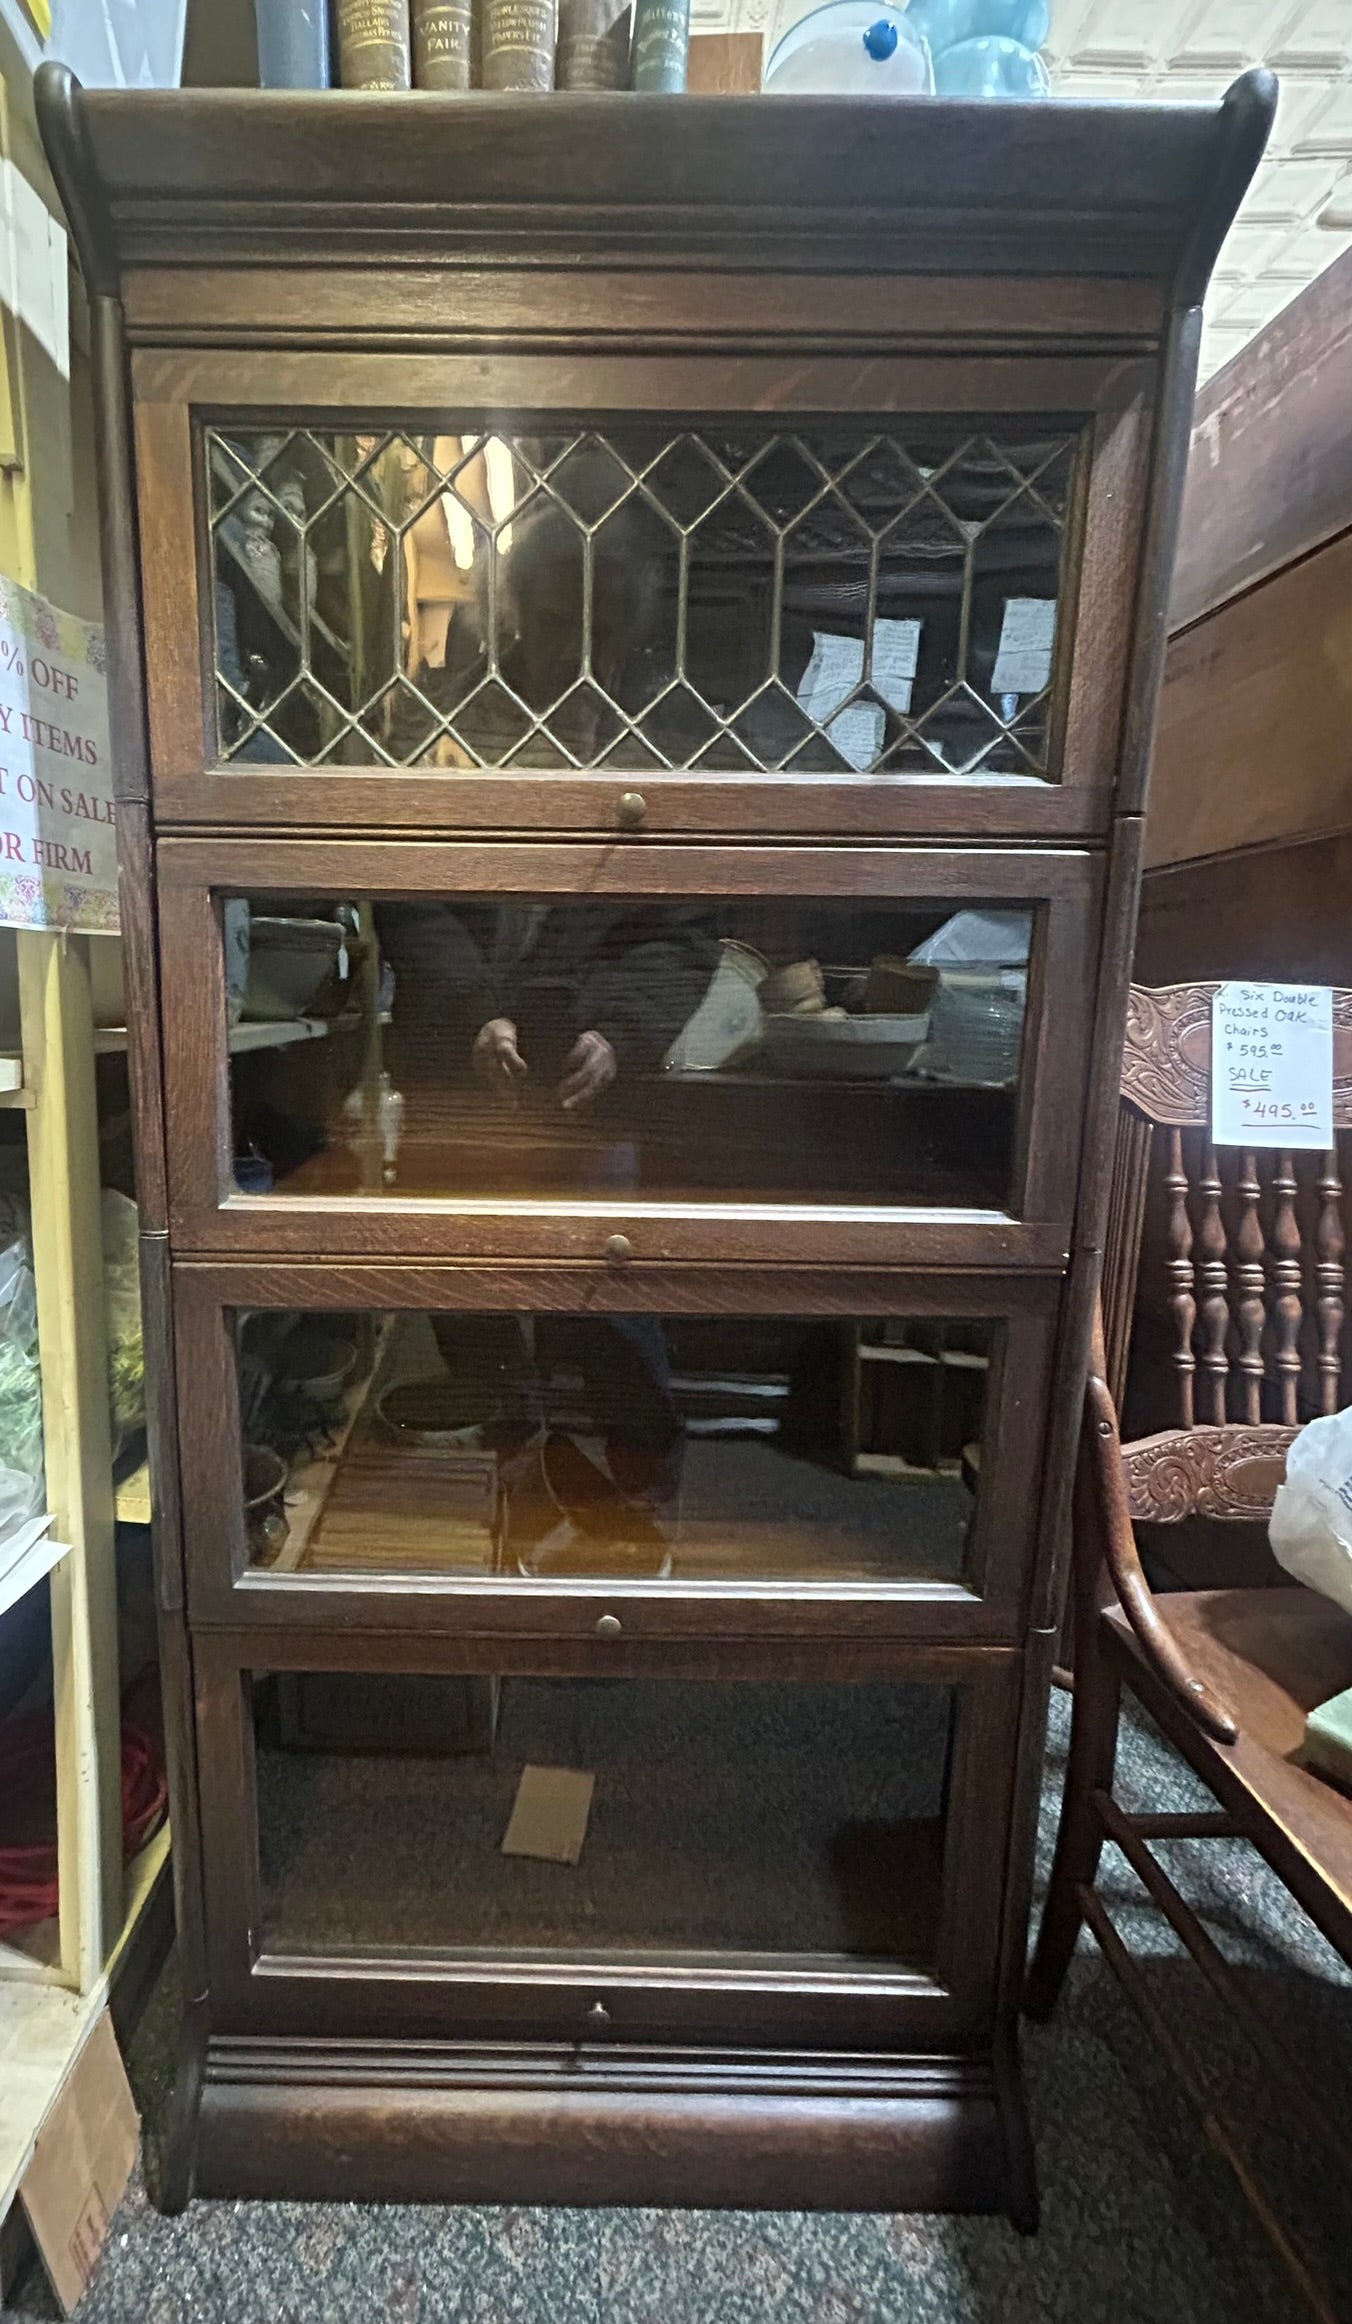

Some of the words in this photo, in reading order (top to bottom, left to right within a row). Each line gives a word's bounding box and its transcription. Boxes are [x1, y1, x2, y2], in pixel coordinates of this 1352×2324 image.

[419, 20, 471, 37] VANITY
[31, 658, 79, 701] OFF
[20, 712, 98, 766] ITEMS
[17, 774, 55, 810] ON
[60, 788, 117, 826] SALE
[32, 838, 94, 875] FIRM
[1273, 990, 1319, 1008] Double
[1219, 1003, 1269, 1019] Pressed
[1224, 1024, 1269, 1038] Chairs
[1228, 1067, 1273, 1082] SALE
